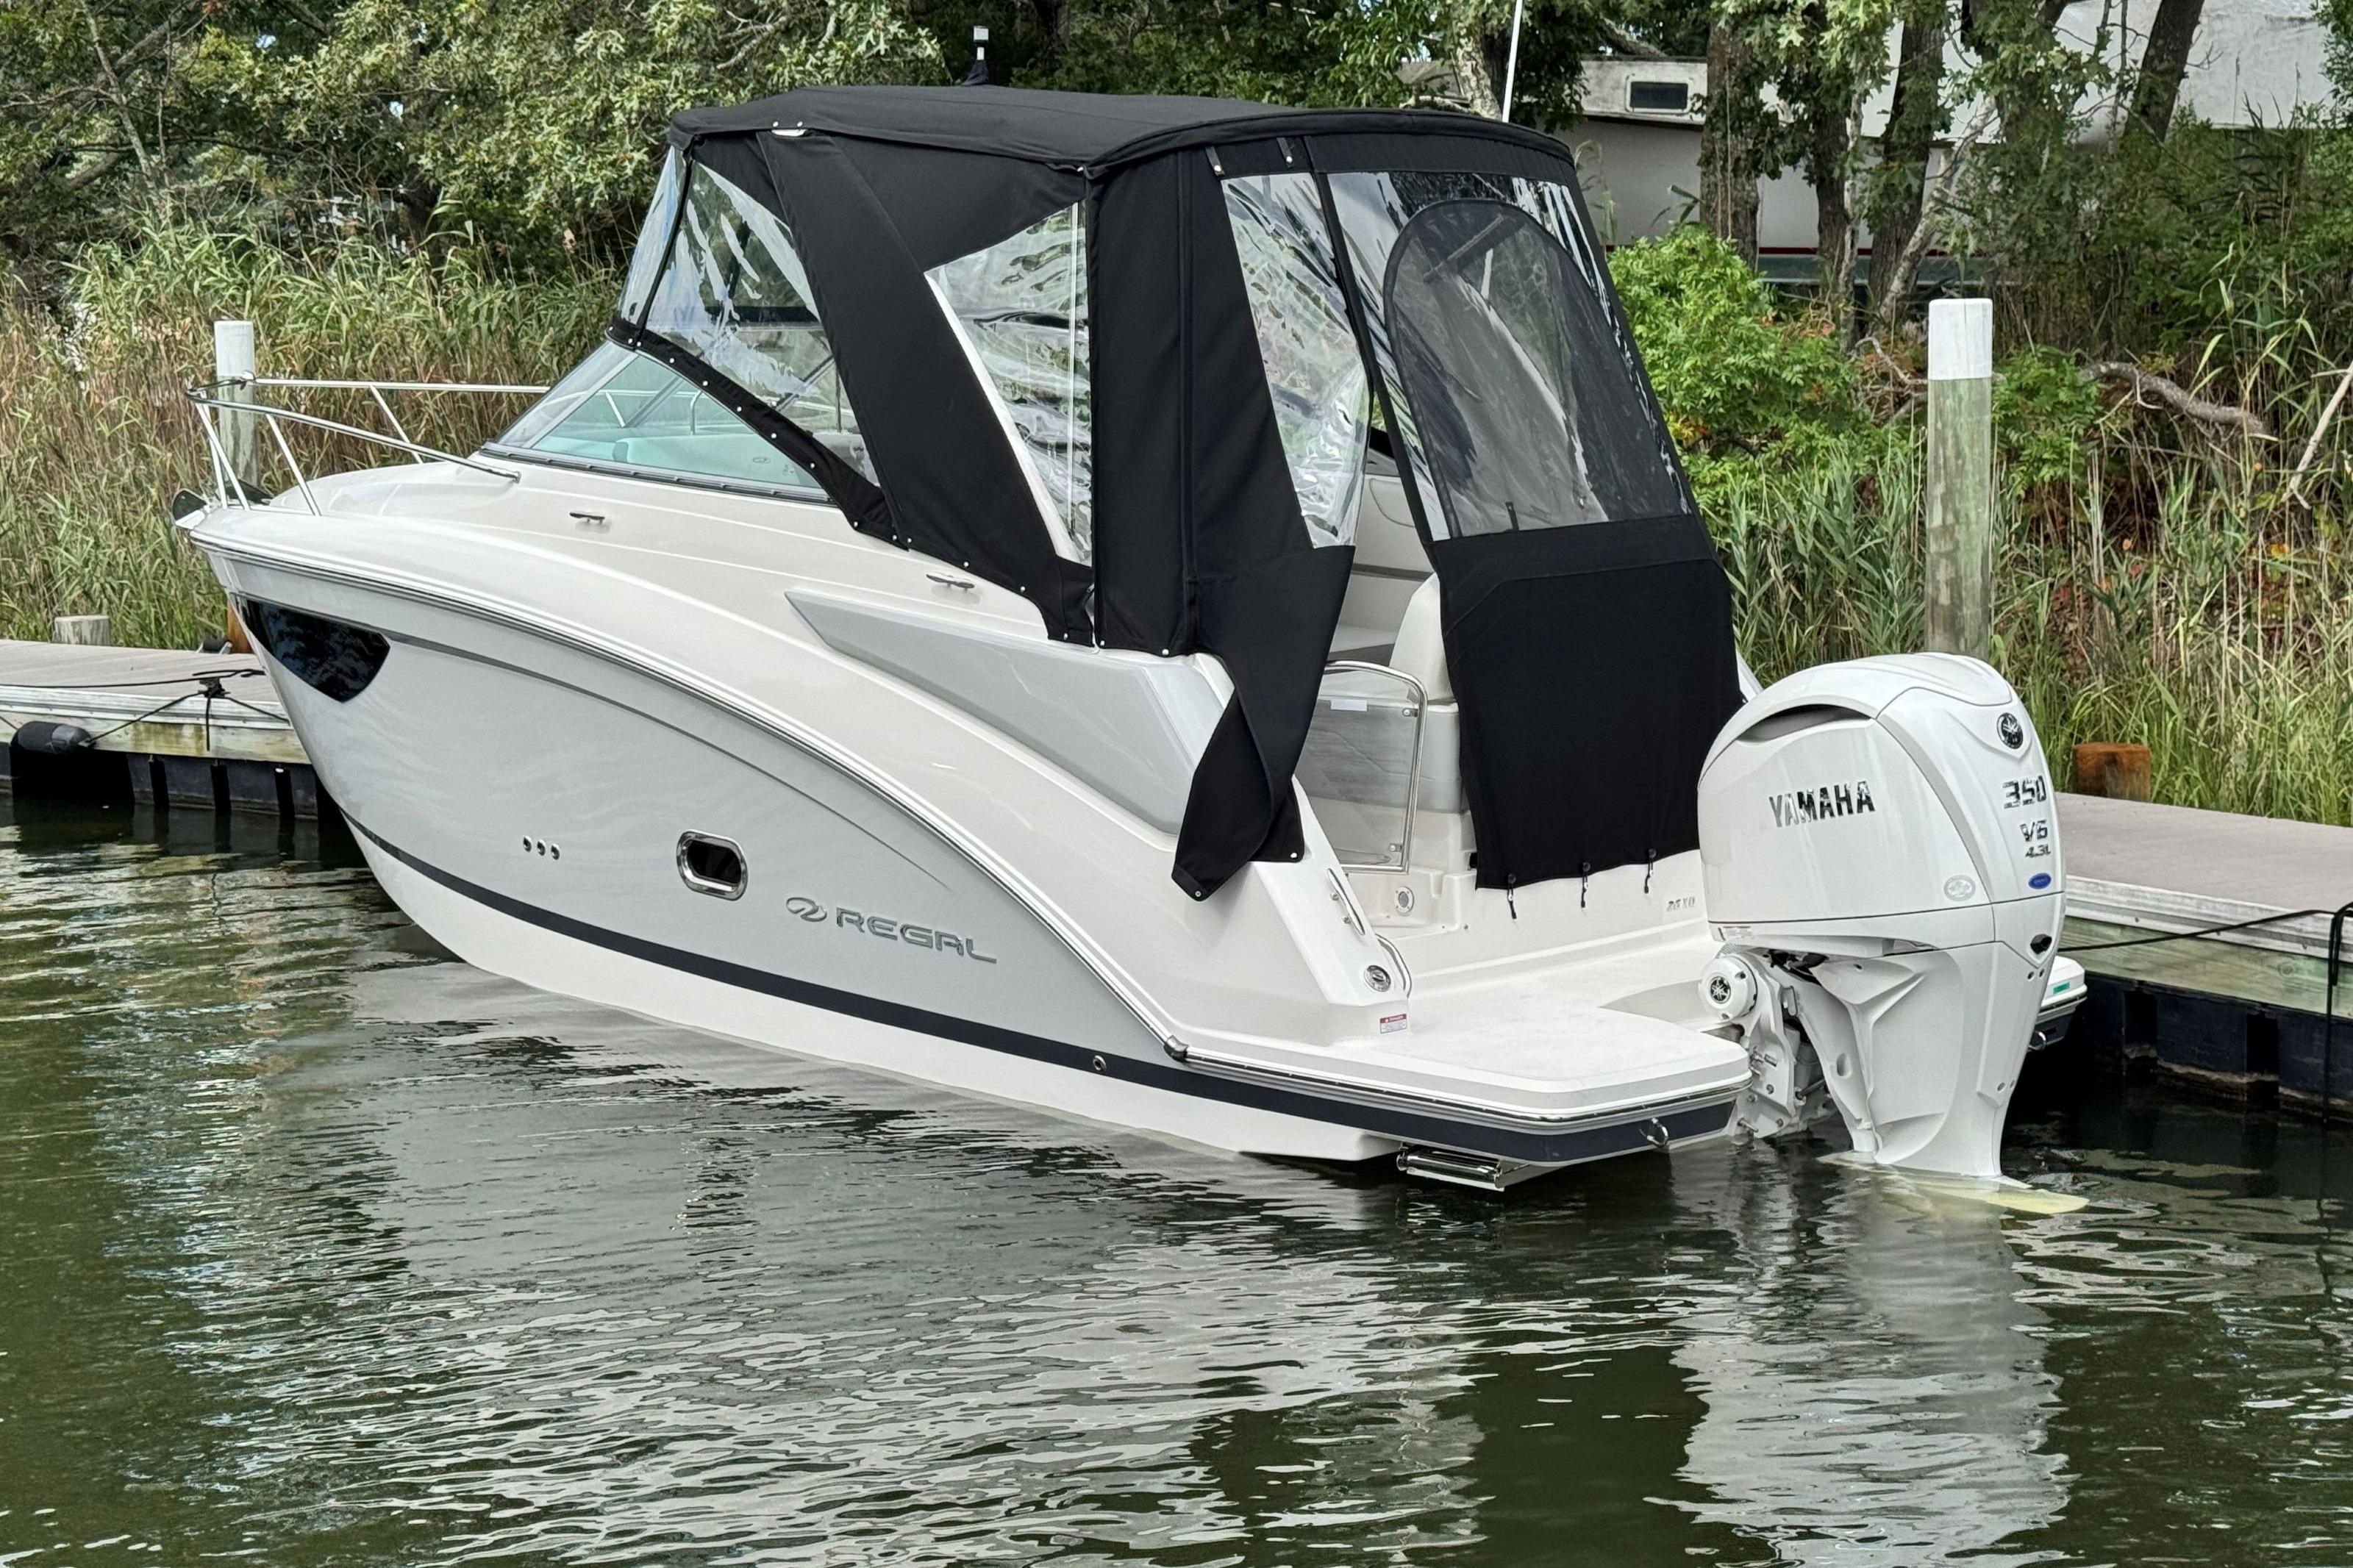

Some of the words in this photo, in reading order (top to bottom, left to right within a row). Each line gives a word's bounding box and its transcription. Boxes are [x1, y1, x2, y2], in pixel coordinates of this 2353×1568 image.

[1768, 780, 1875, 828] YAMAHA
[2002, 776, 2046, 809] 350
[2019, 819, 2048, 842] V6
[836, 906, 997, 964] REGAL
